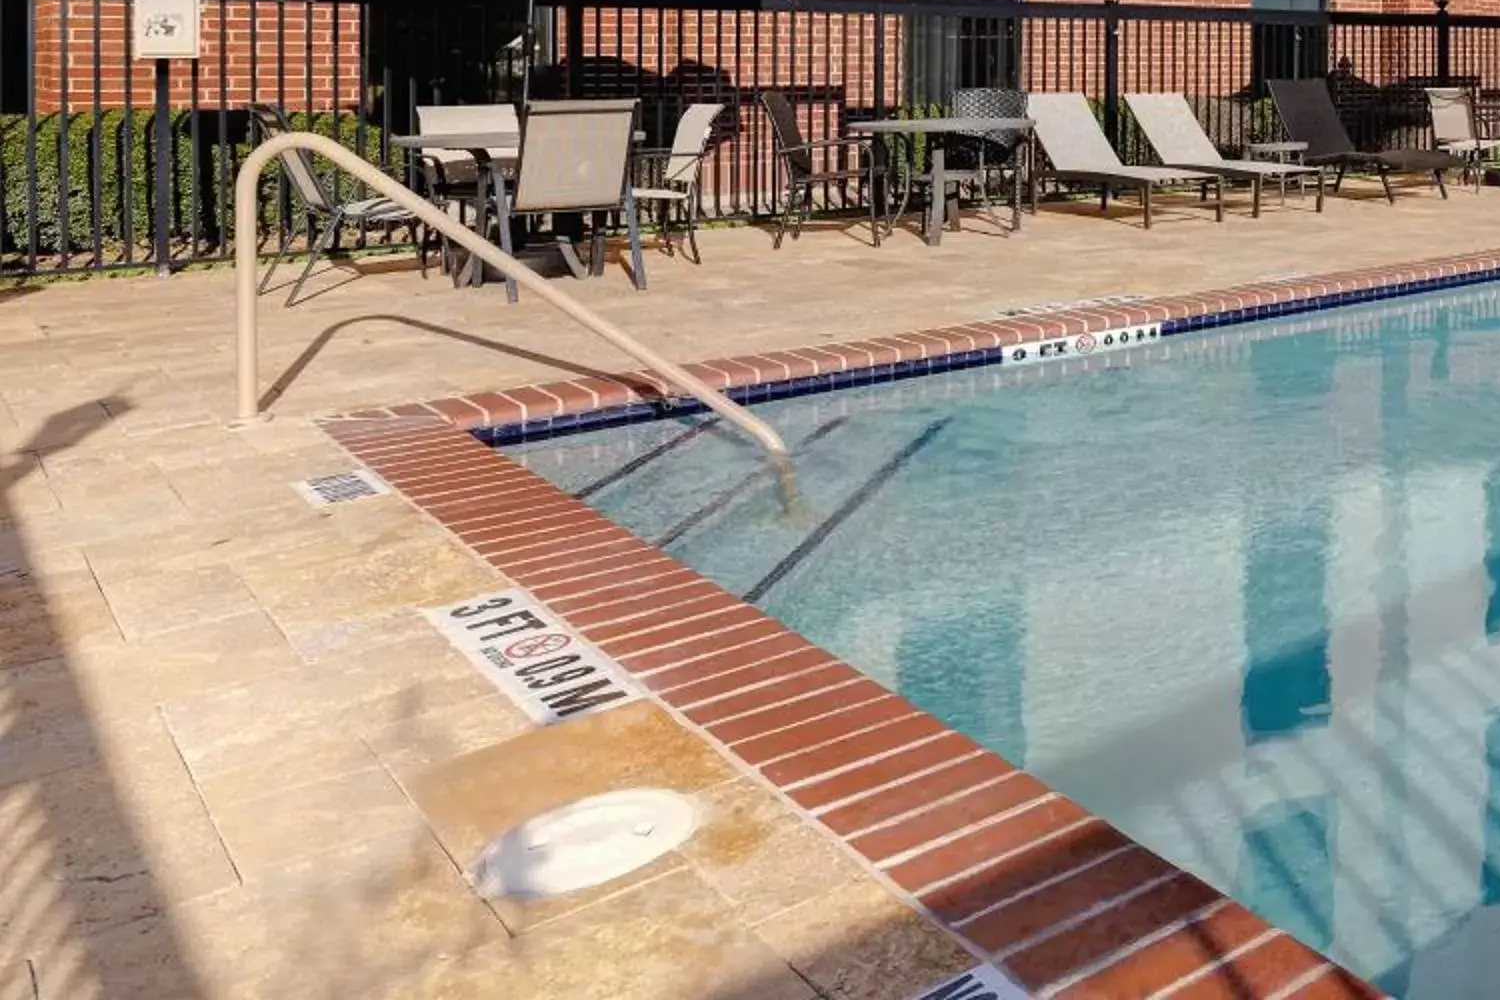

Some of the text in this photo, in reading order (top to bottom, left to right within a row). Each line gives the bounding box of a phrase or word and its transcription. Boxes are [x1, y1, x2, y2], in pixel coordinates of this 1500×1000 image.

[450, 597, 513, 617] 3
[466, 609, 548, 641] FT
[540, 678, 629, 717] M
